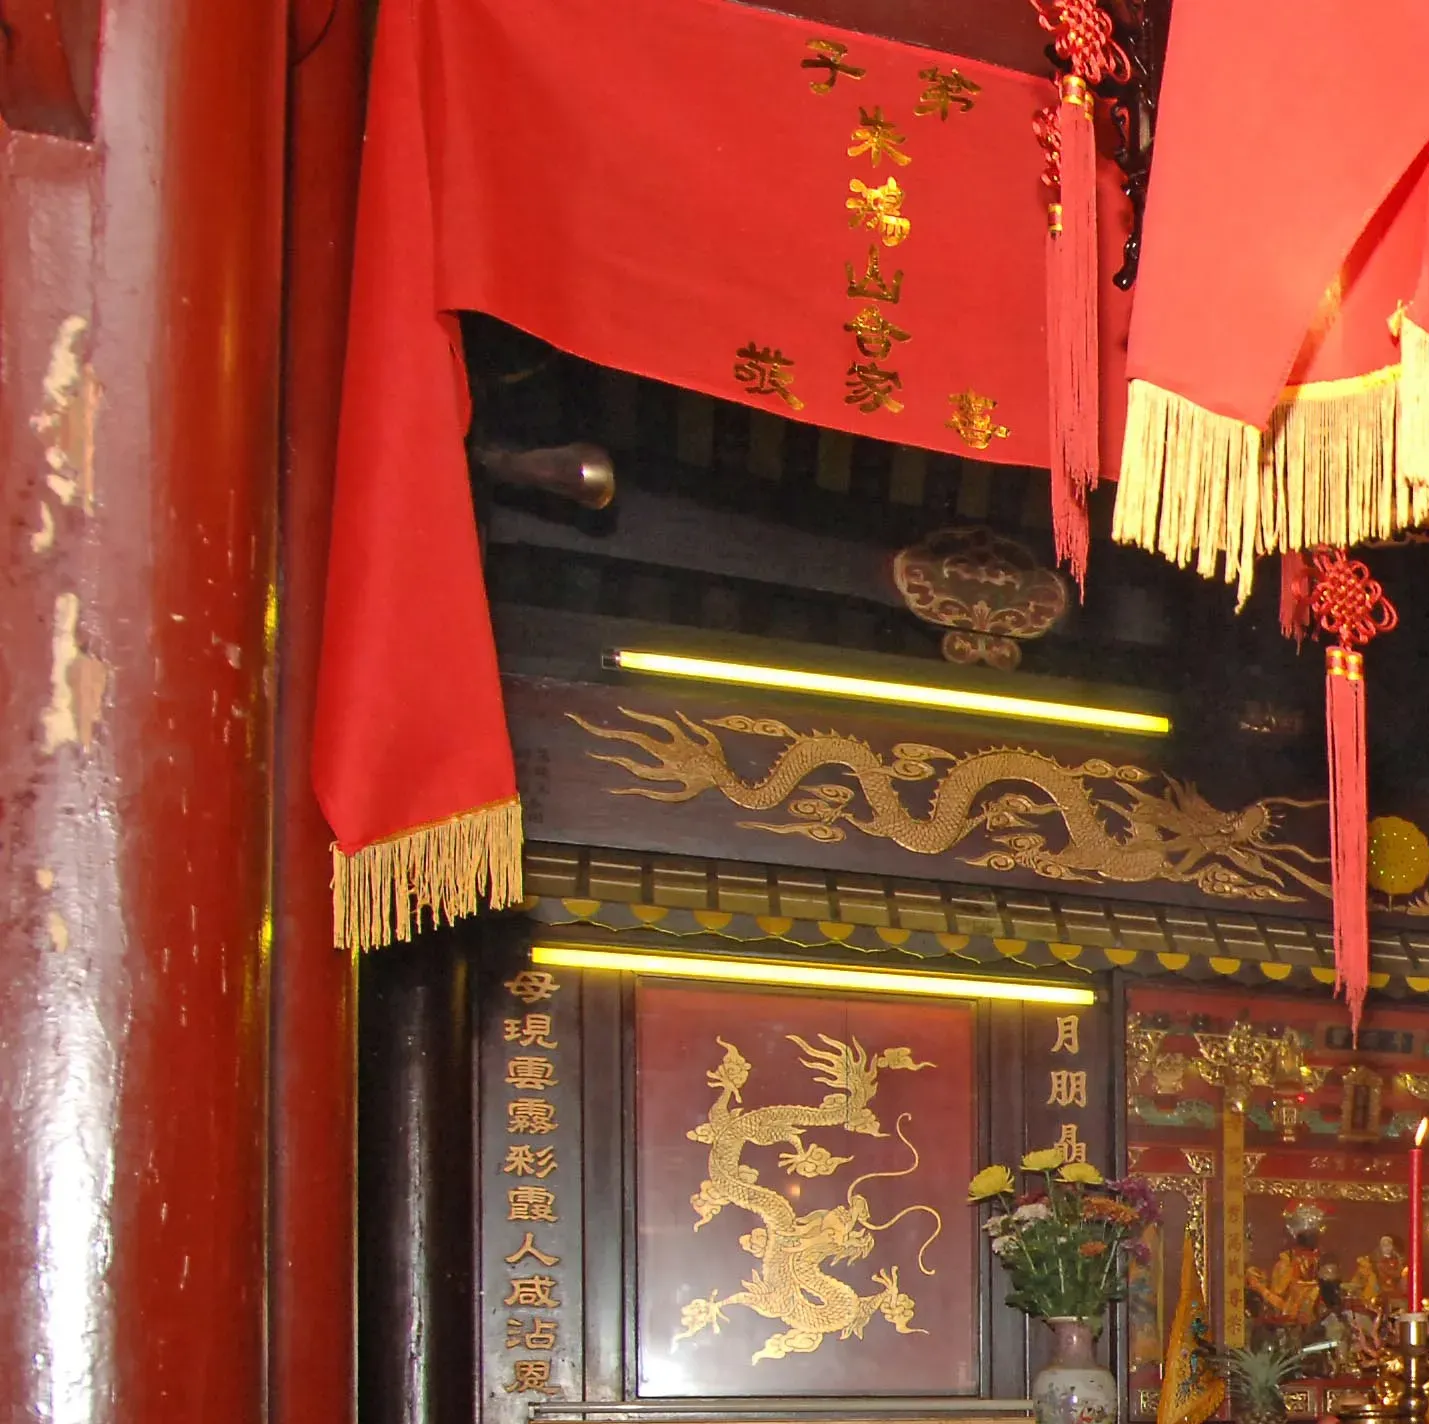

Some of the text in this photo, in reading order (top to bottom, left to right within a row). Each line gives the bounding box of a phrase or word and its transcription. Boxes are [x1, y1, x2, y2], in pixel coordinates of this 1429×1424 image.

[503, 970, 561, 1398] 母現雲霧彩霞人咸沾恩
